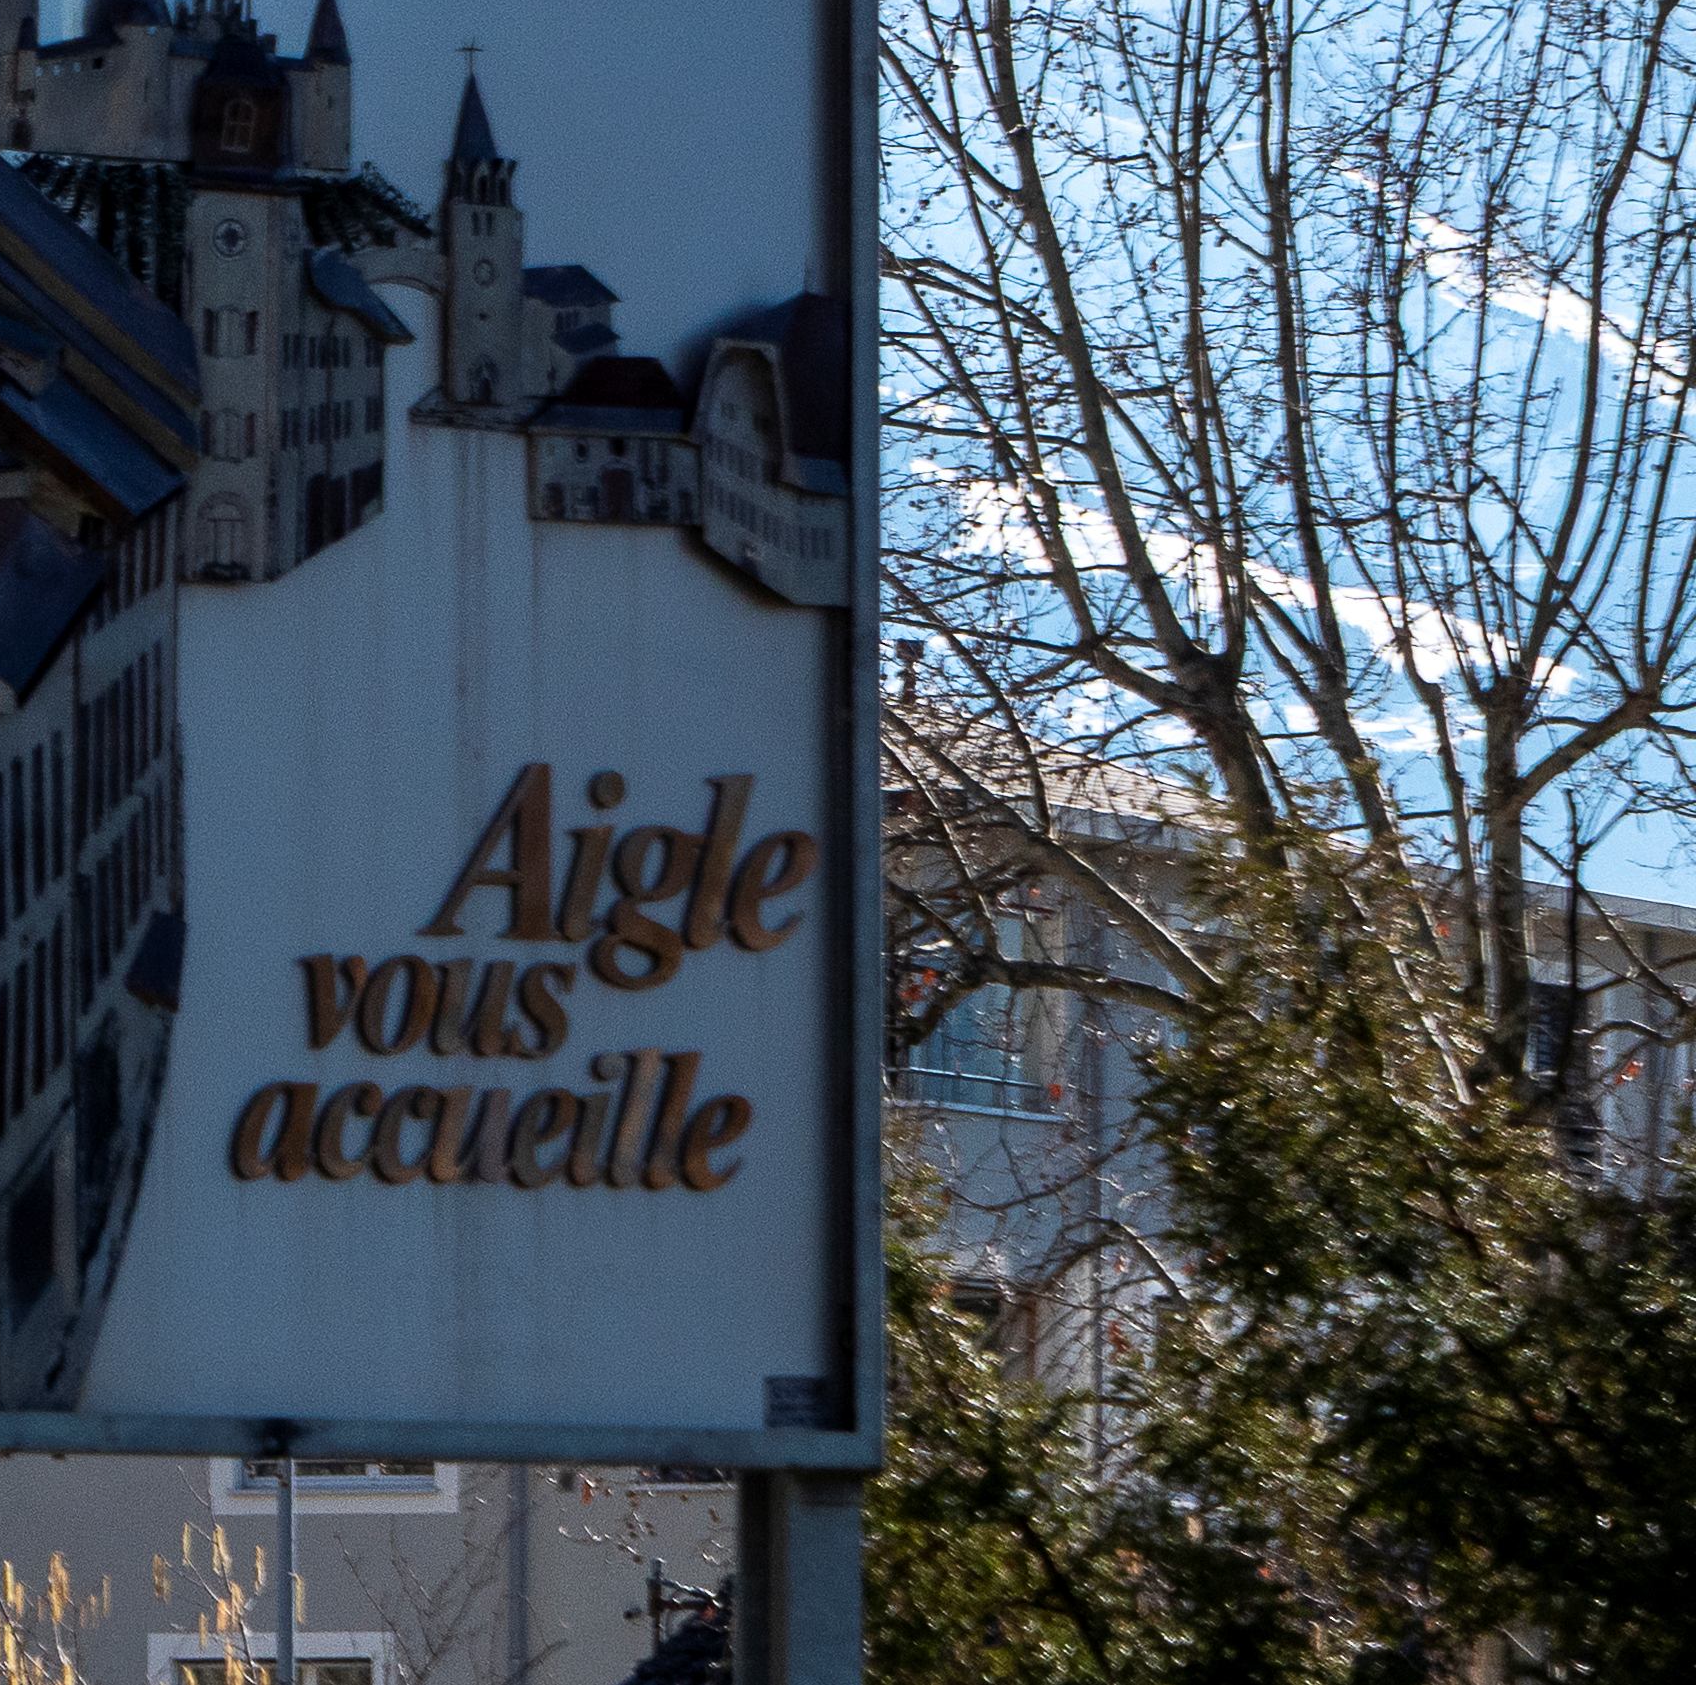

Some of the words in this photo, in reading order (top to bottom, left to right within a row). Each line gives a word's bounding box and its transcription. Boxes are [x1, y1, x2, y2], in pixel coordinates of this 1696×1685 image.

[418, 763, 819, 990] Aigle
[300, 954, 577, 1060] vous
[230, 1047, 753, 1192] accueille
